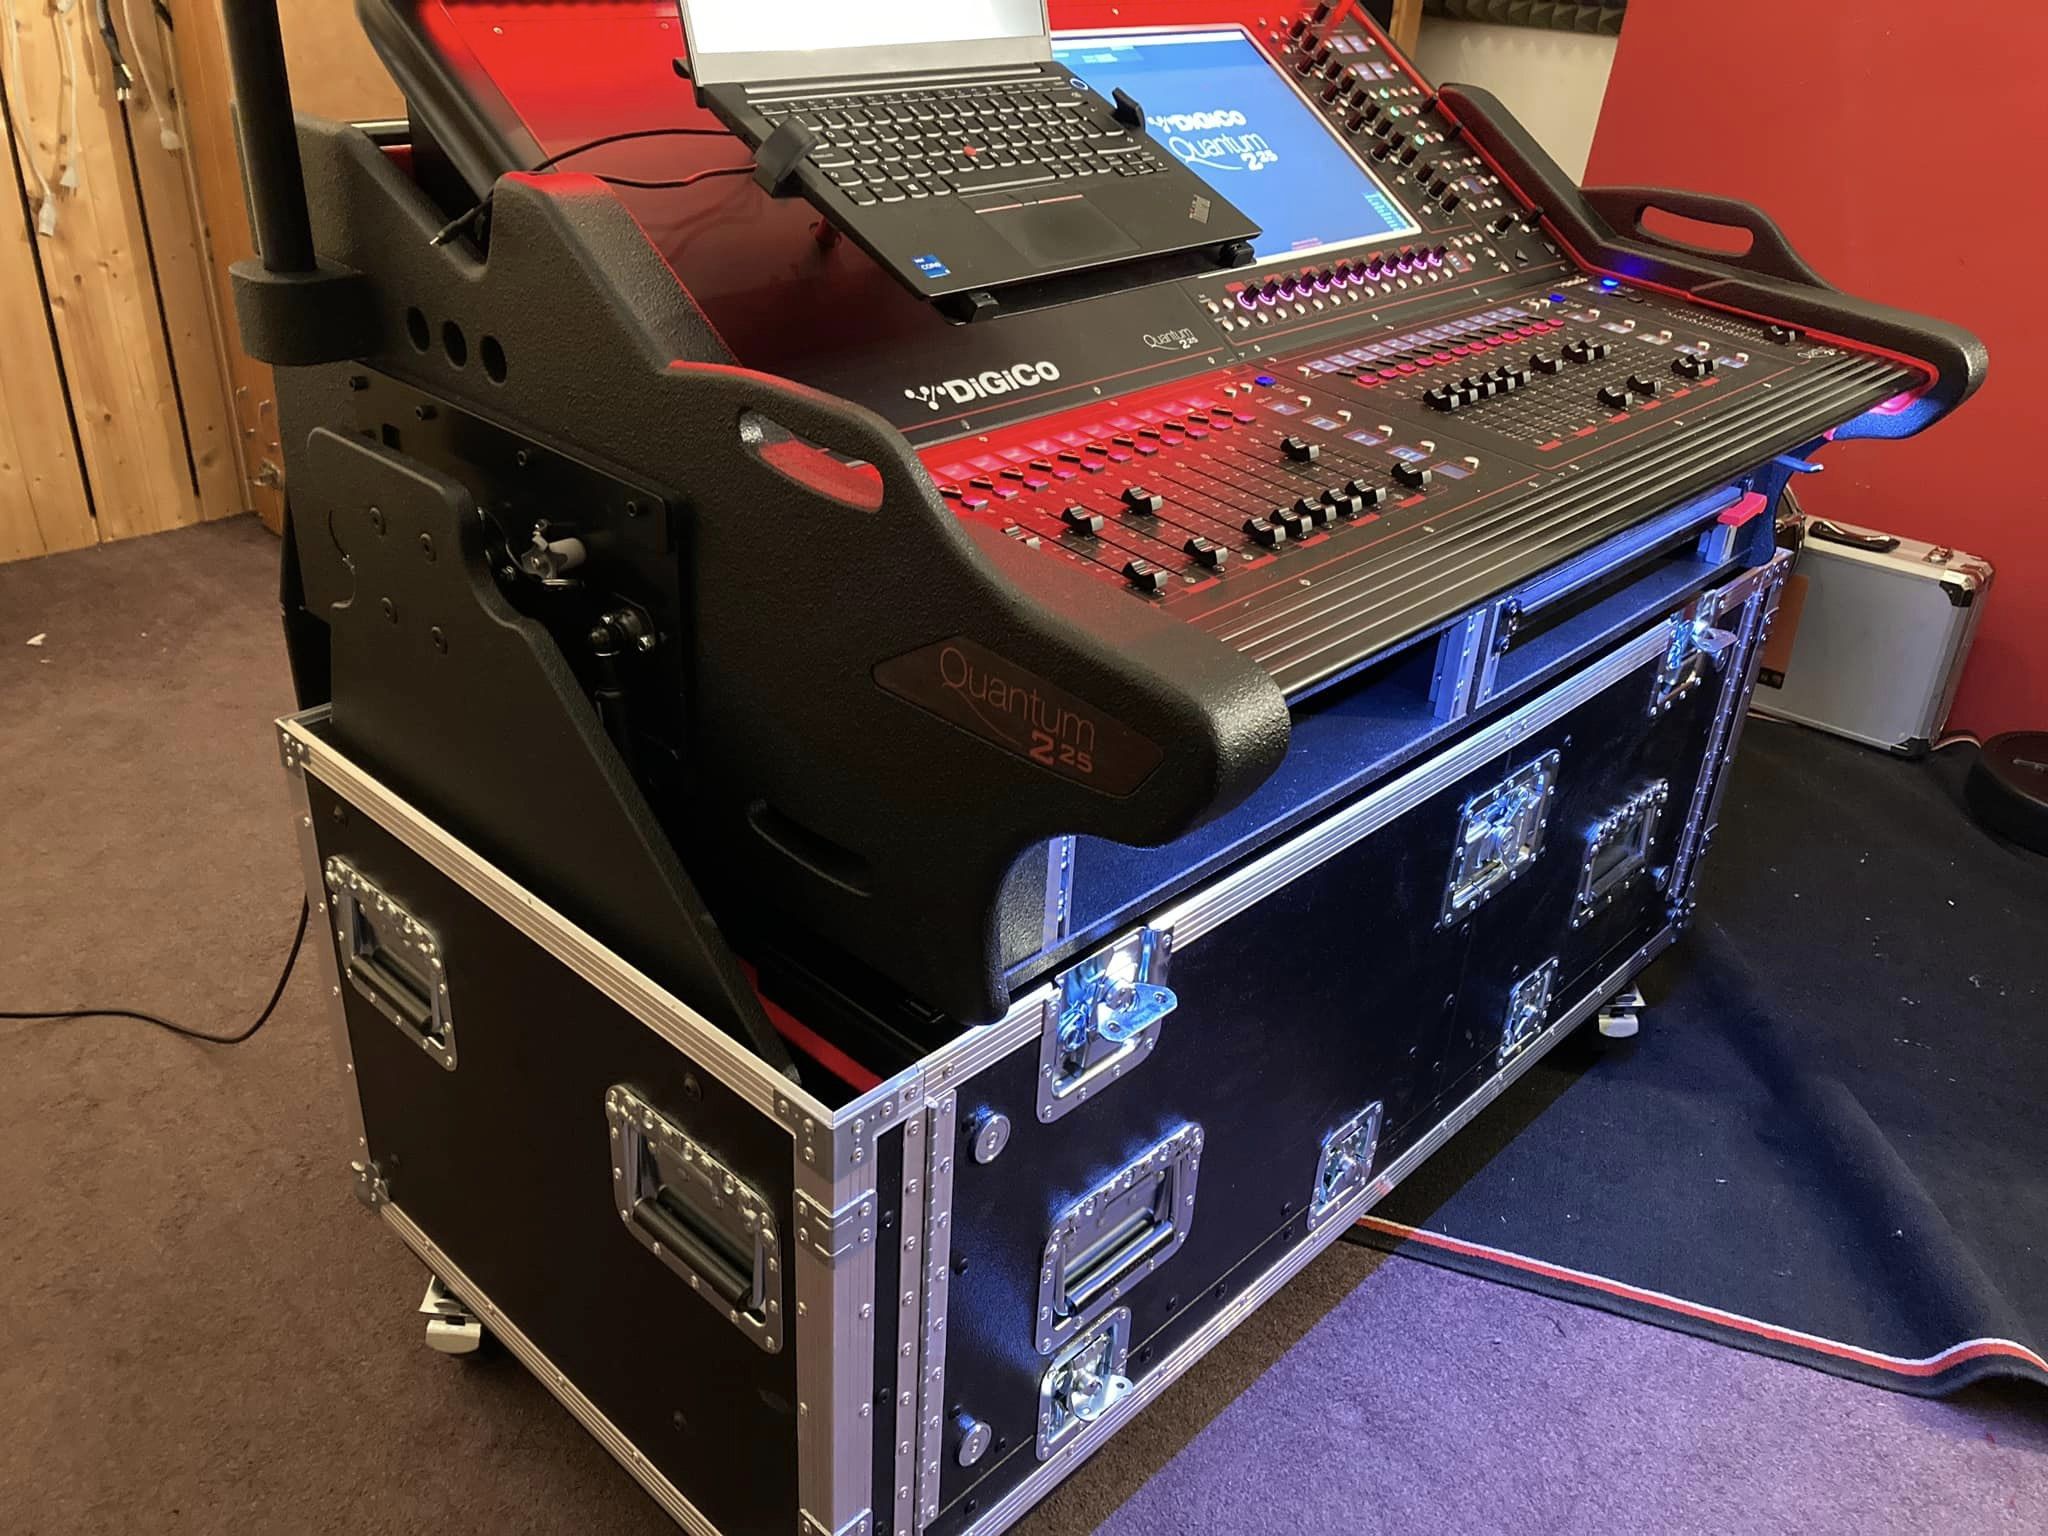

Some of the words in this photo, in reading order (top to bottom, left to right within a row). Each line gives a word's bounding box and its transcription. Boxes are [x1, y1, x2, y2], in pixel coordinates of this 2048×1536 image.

[1168, 132, 1269, 168] Quantum
[1143, 328, 1194, 350] Quantum
[941, 360, 1060, 403] DiGiCo
[939, 647, 1095, 752] Quantum
